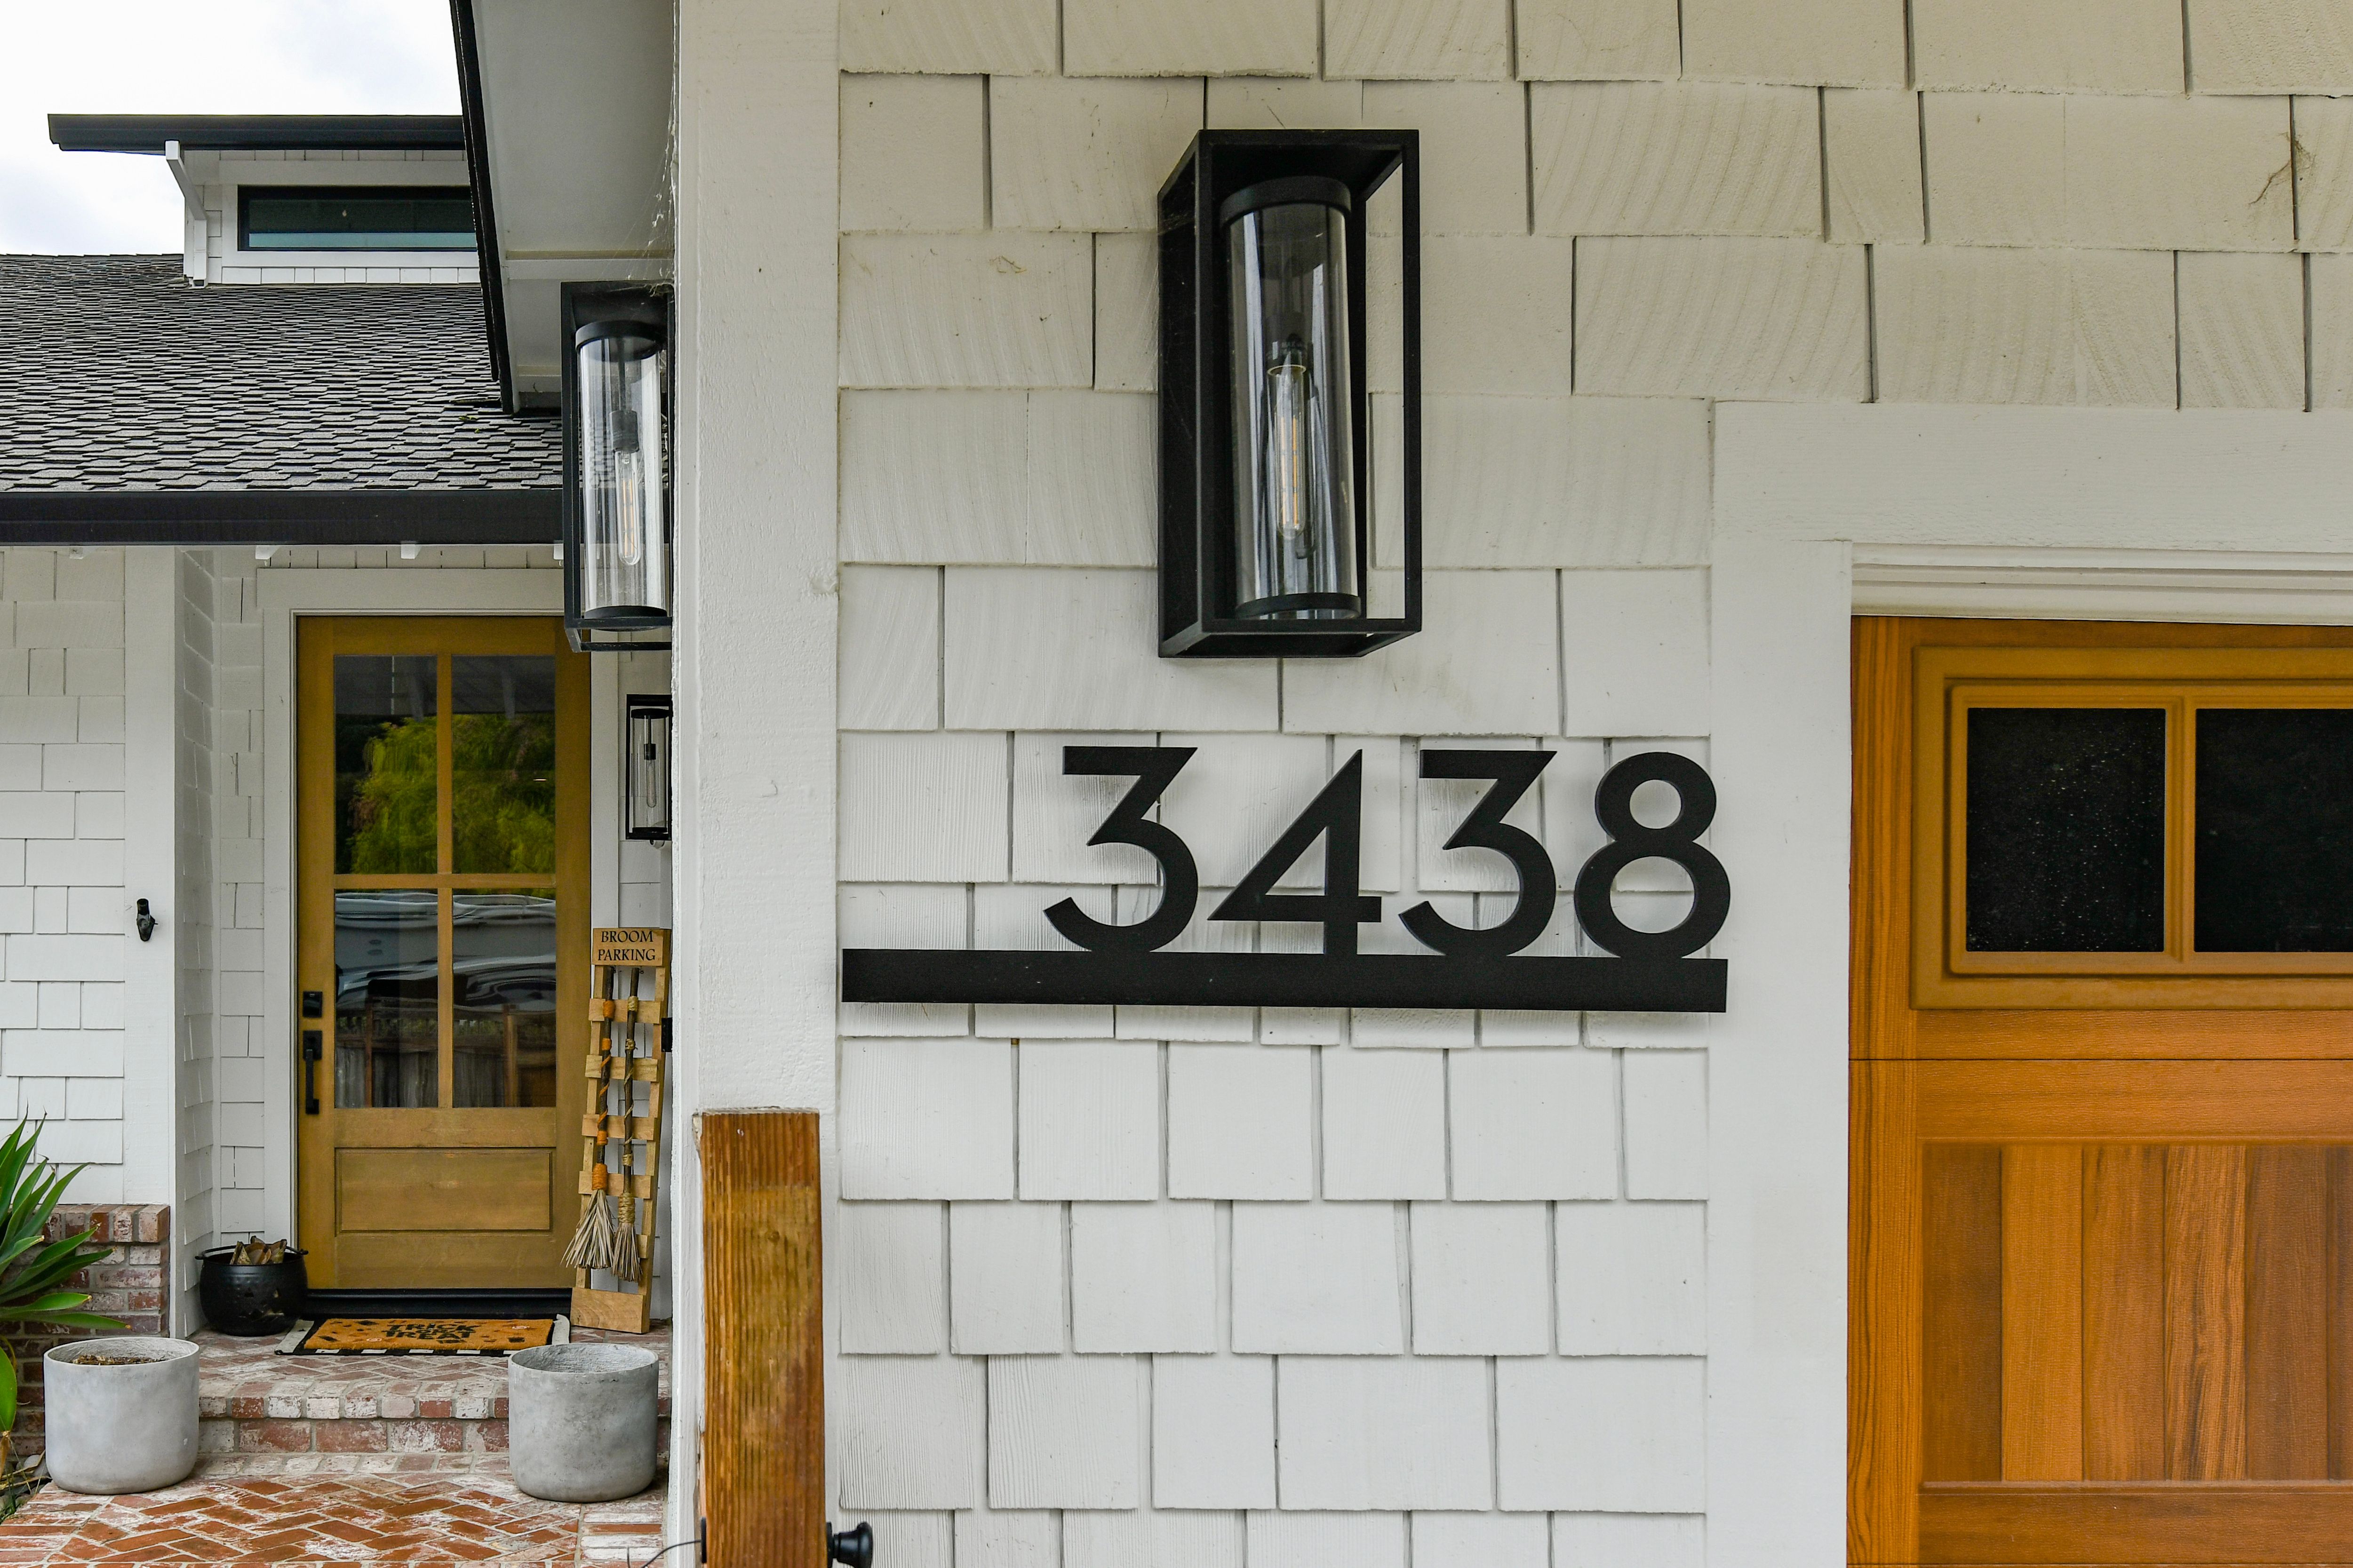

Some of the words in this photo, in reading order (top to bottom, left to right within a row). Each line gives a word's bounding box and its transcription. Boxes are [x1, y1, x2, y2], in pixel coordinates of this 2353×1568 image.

[1044, 746, 1731, 961] 3438
[601, 930, 654, 943] BROOM
[598, 948, 656, 961] PARKING
[387, 1322, 481, 1331] TRICK
[381, 1329, 476, 1339] TREAT
